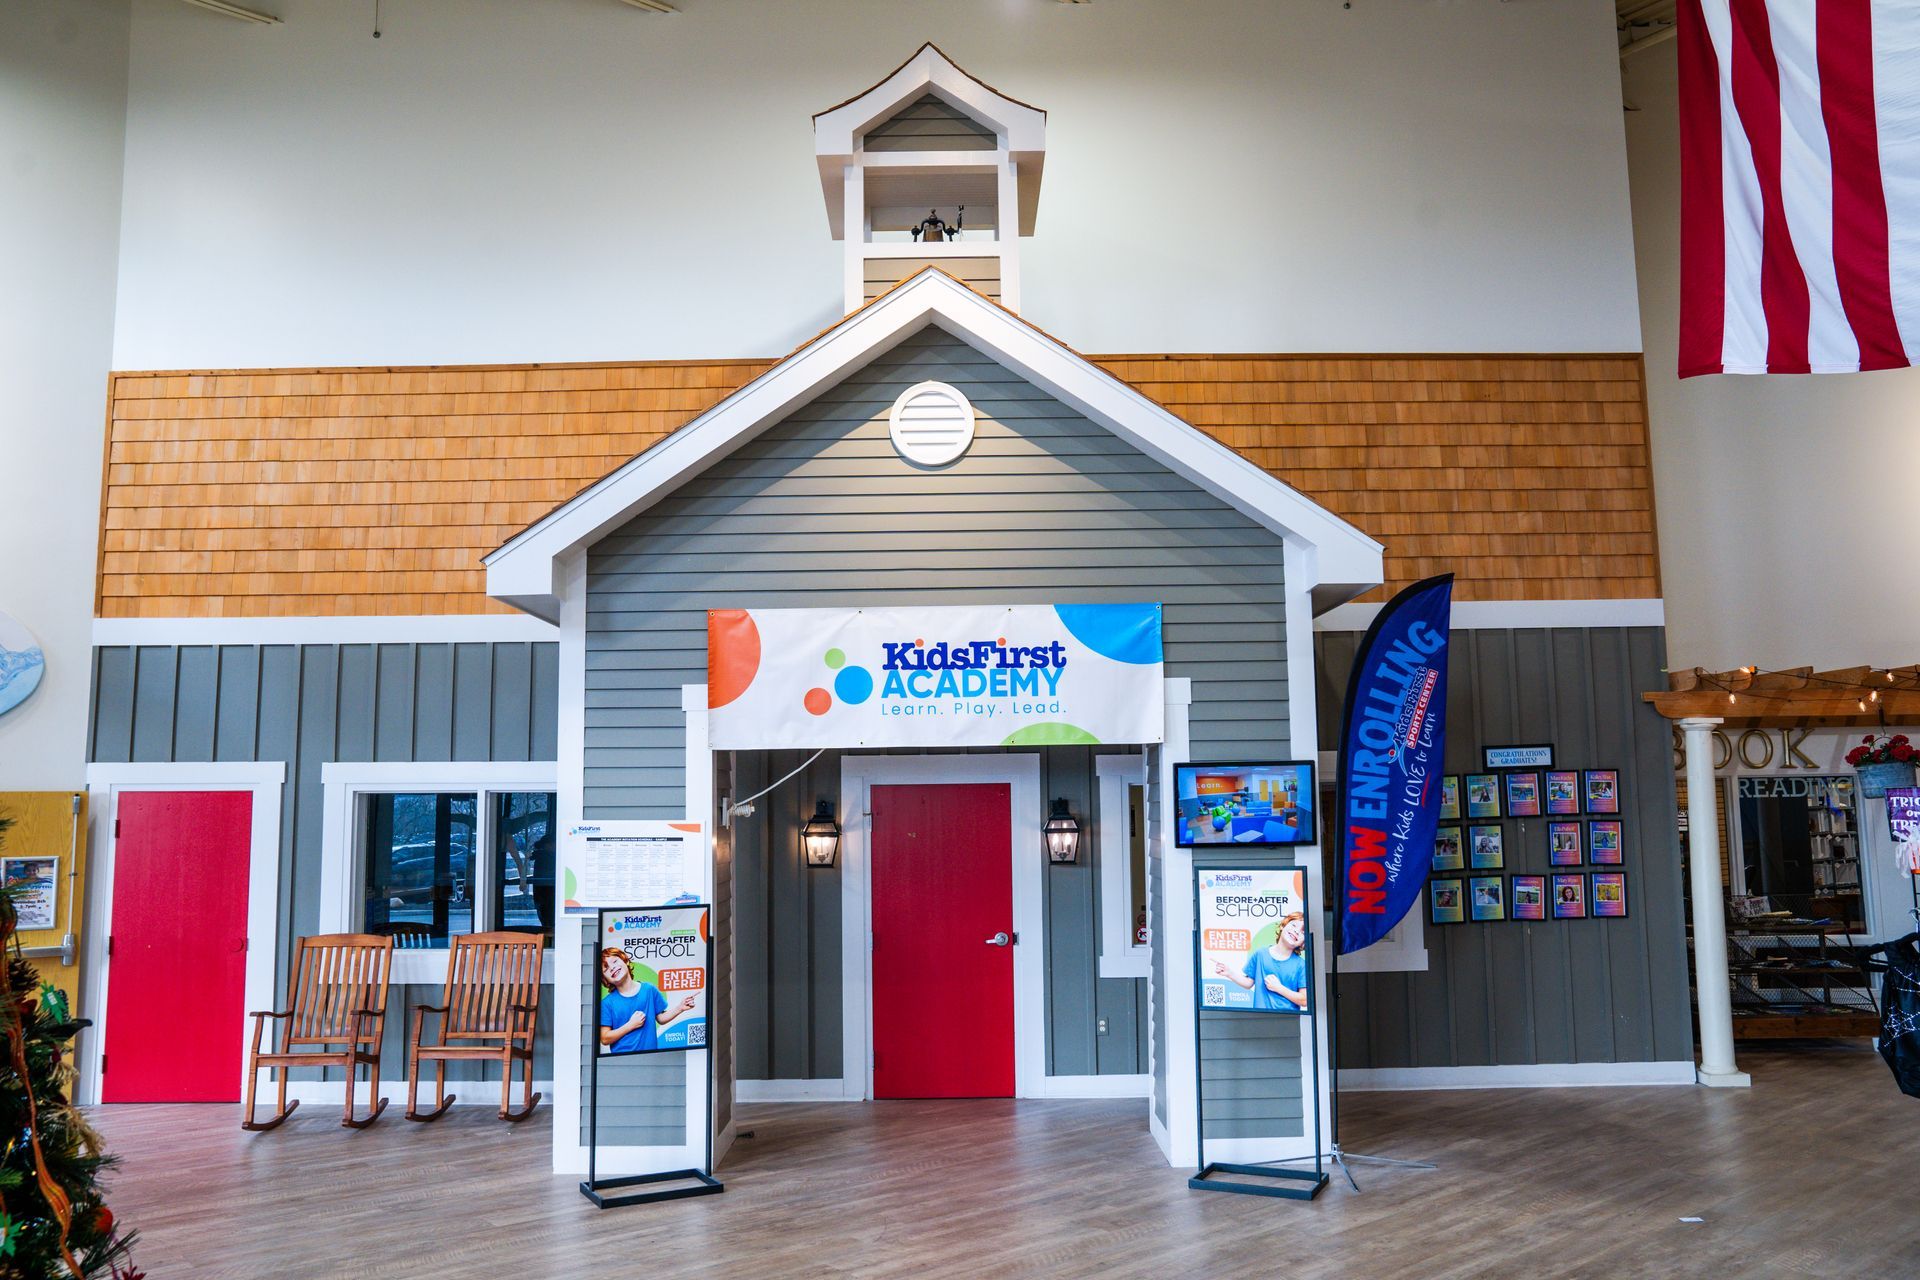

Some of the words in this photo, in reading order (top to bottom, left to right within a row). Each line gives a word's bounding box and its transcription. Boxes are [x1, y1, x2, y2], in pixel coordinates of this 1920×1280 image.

[882, 637, 1067, 671] KidsFirst
[881, 668, 1065, 698] ACADEMY
[881, 703, 944, 716] Learn.
[954, 702, 1002, 718] Play.
[1013, 701, 1067, 714] Lead.
[1407, 709, 1424, 748] SPORTS
[1419, 670, 1437, 708] CENTER
[1351, 621, 1446, 819] ENROLLING
[1418, 712, 1436, 747] Learn
[1416, 750, 1428, 762] to
[1490, 750, 1547, 758] CONGRATULATIONS
[1404, 764, 1426, 806] LOVE
[1739, 777, 1855, 798] READING
[1392, 810, 1414, 840] Kids
[1349, 826, 1387, 914] NOW
[624, 915, 662, 923] KidsFirst
[1216, 904, 1287, 917] SCHOOL
[1209, 931, 1247, 941] ENTER
[1209, 940, 1247, 949] HERE!
[624, 944, 695, 960] SCHOOL
[664, 970, 701, 981] ENTER
[664, 979, 700, 990] HERE!
